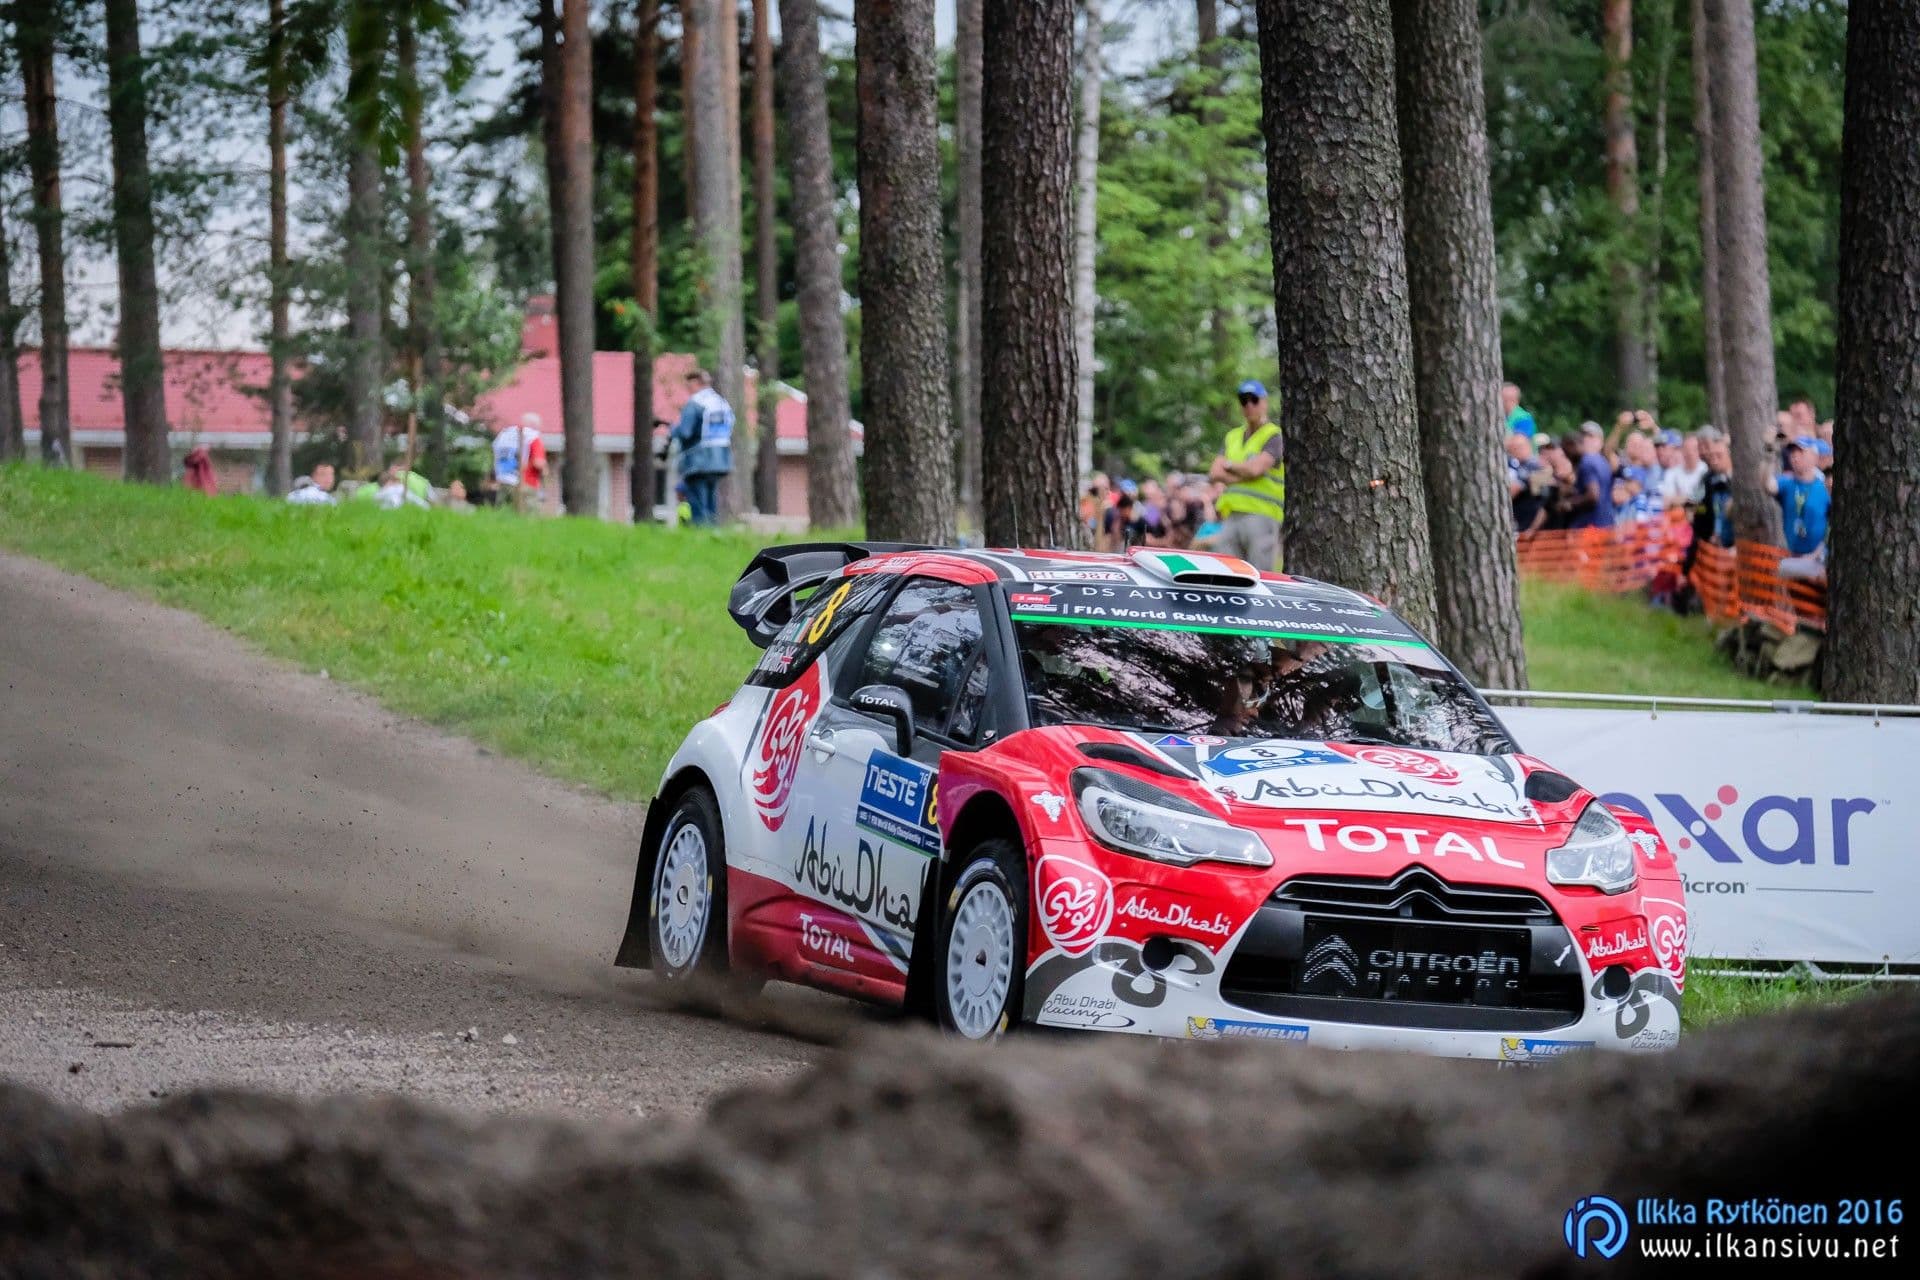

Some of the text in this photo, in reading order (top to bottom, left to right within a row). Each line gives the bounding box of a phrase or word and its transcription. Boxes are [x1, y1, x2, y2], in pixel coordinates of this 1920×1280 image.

[1082, 587, 1323, 612] DS AUTOMOBILES
[808, 582, 851, 645] 8
[1073, 605, 1345, 634] FIA World Rally Championship
[860, 694, 898, 708] TOTAL
[1237, 756, 1328, 771] NESTE
[1250, 748, 1277, 758] 8
[866, 764, 918, 807] NESTE
[1284, 818, 1525, 869] TOTAL
[1680, 873, 1746, 894] icron
[800, 913, 855, 963] TOTAL
[1054, 994, 1116, 1010] Abu Dhabi
[1221, 1025, 1307, 1040] MICHELIN
